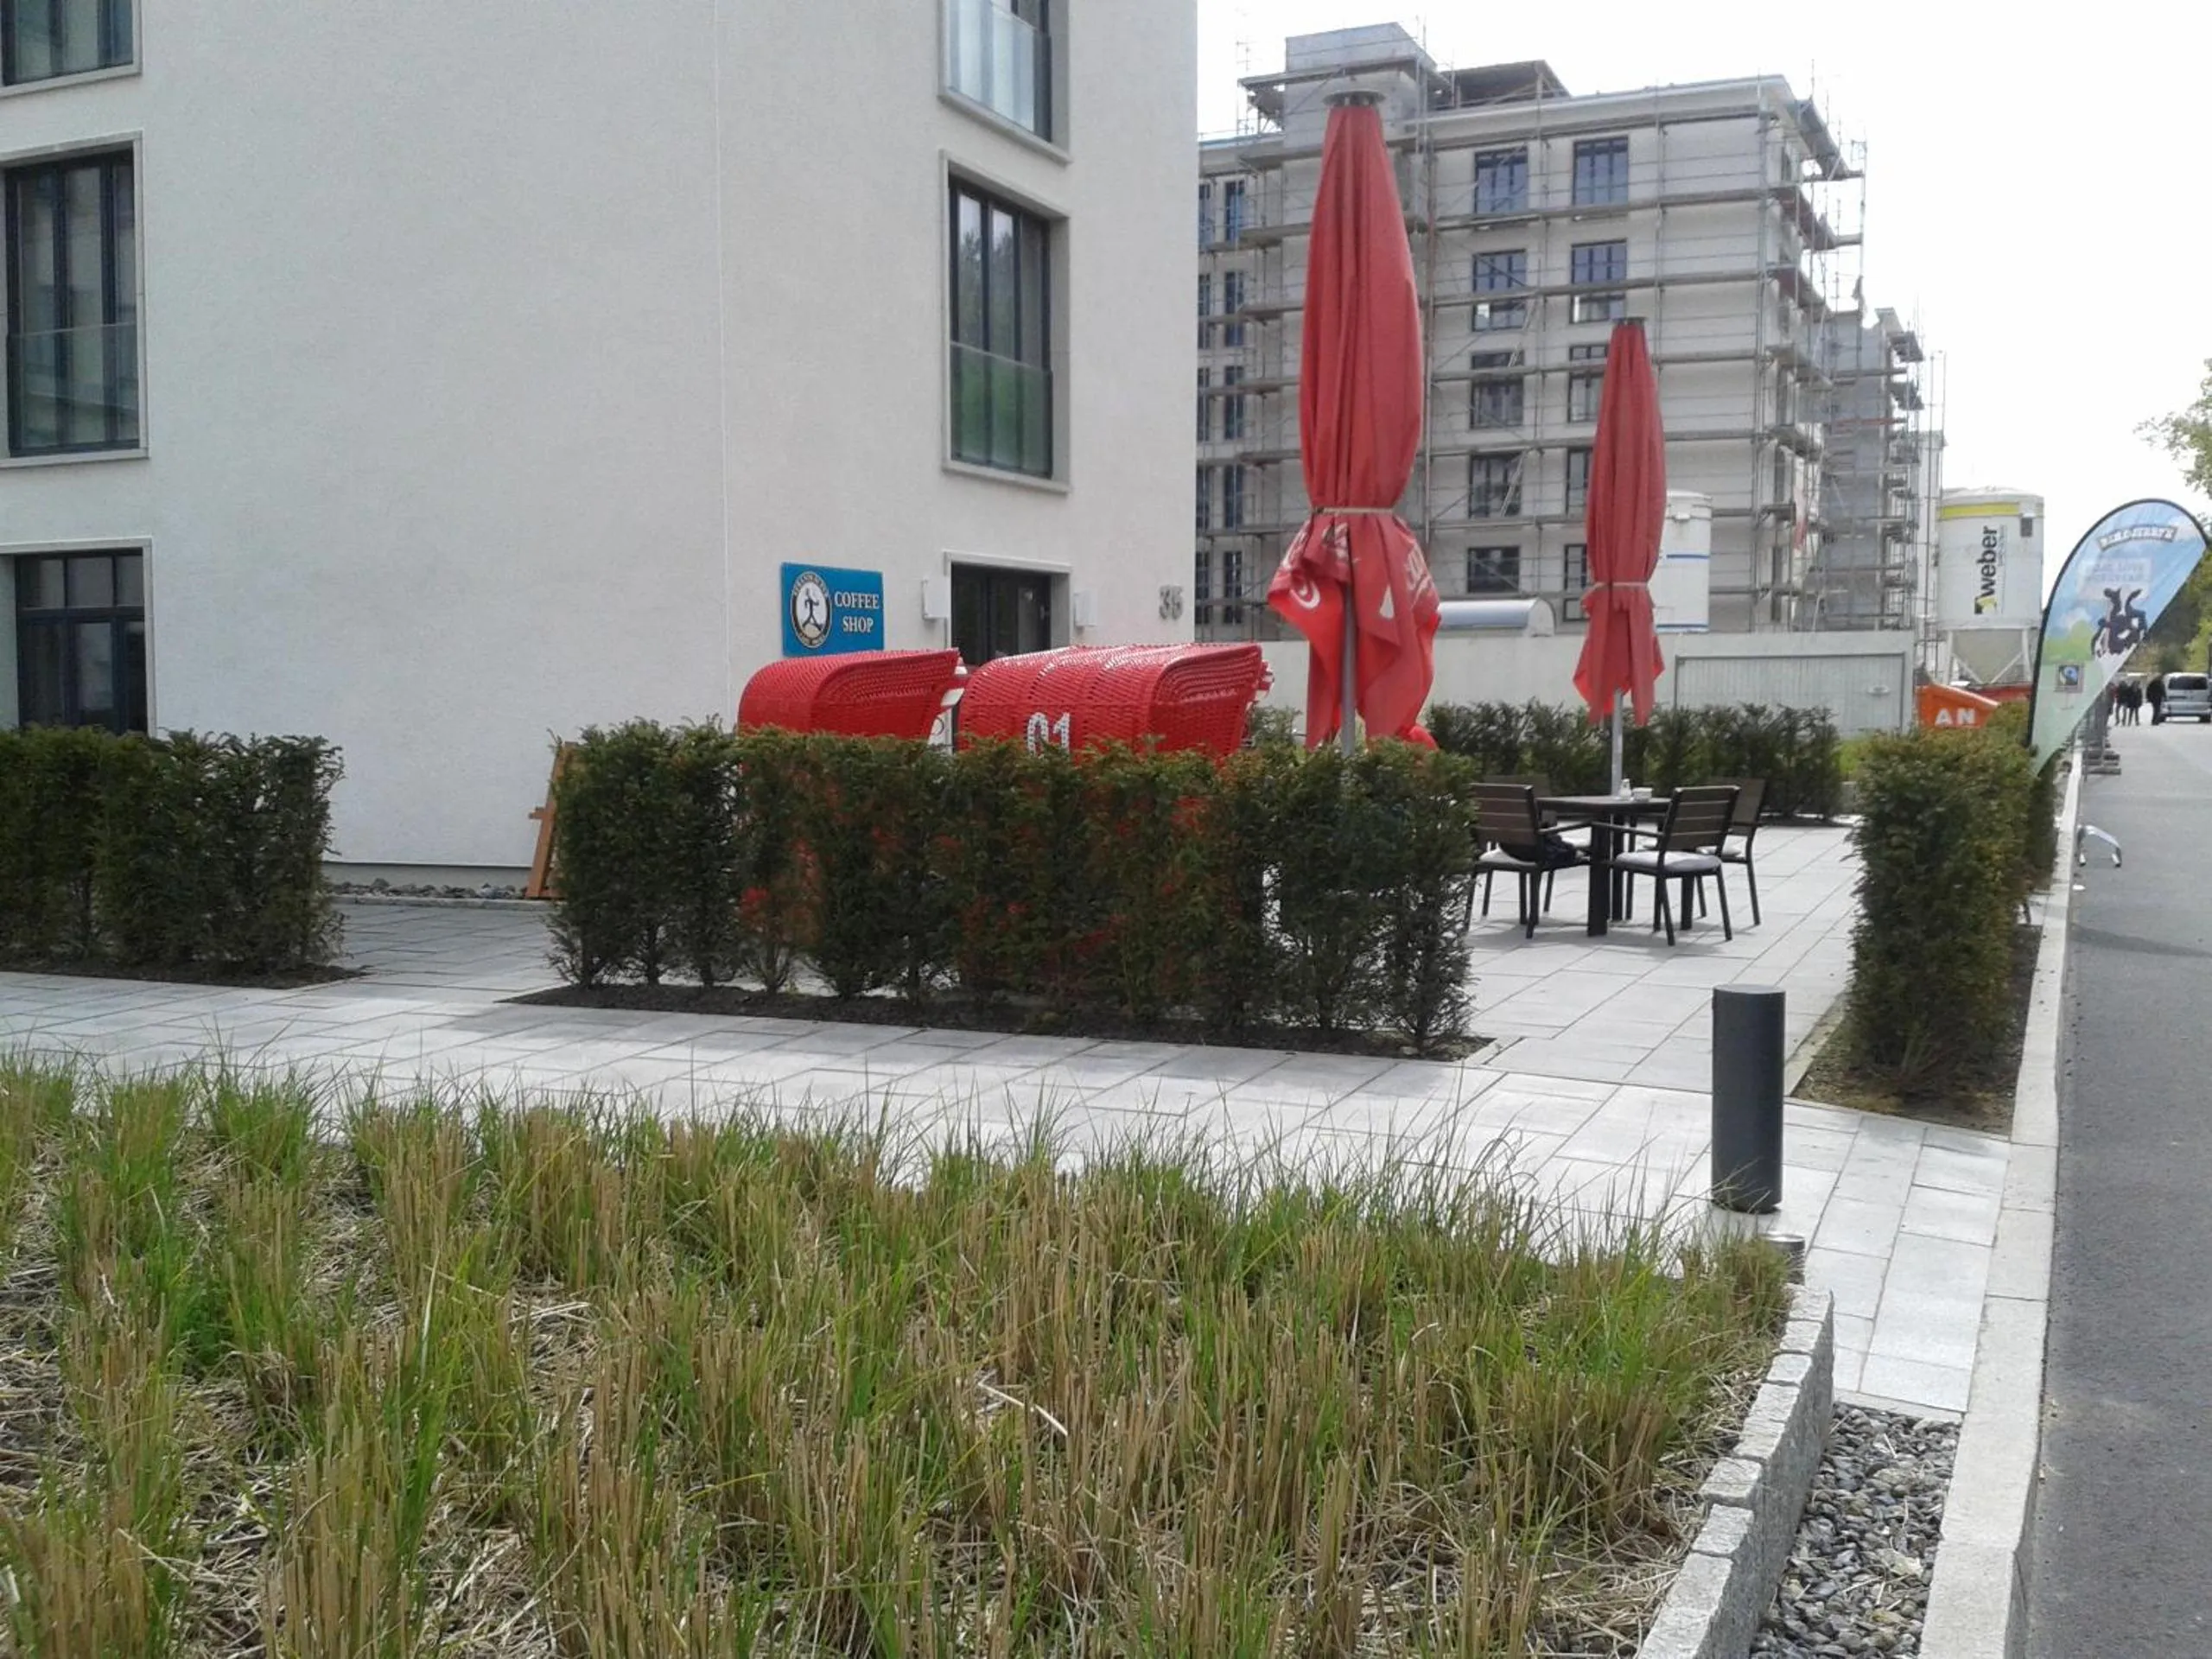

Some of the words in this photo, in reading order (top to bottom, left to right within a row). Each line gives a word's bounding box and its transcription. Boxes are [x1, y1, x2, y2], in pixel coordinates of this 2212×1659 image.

[1976, 525, 1998, 598] weber
[834, 591, 880, 609] COFFEE
[842, 615, 874, 633] SHOP
[1027, 711, 1071, 760] 01
